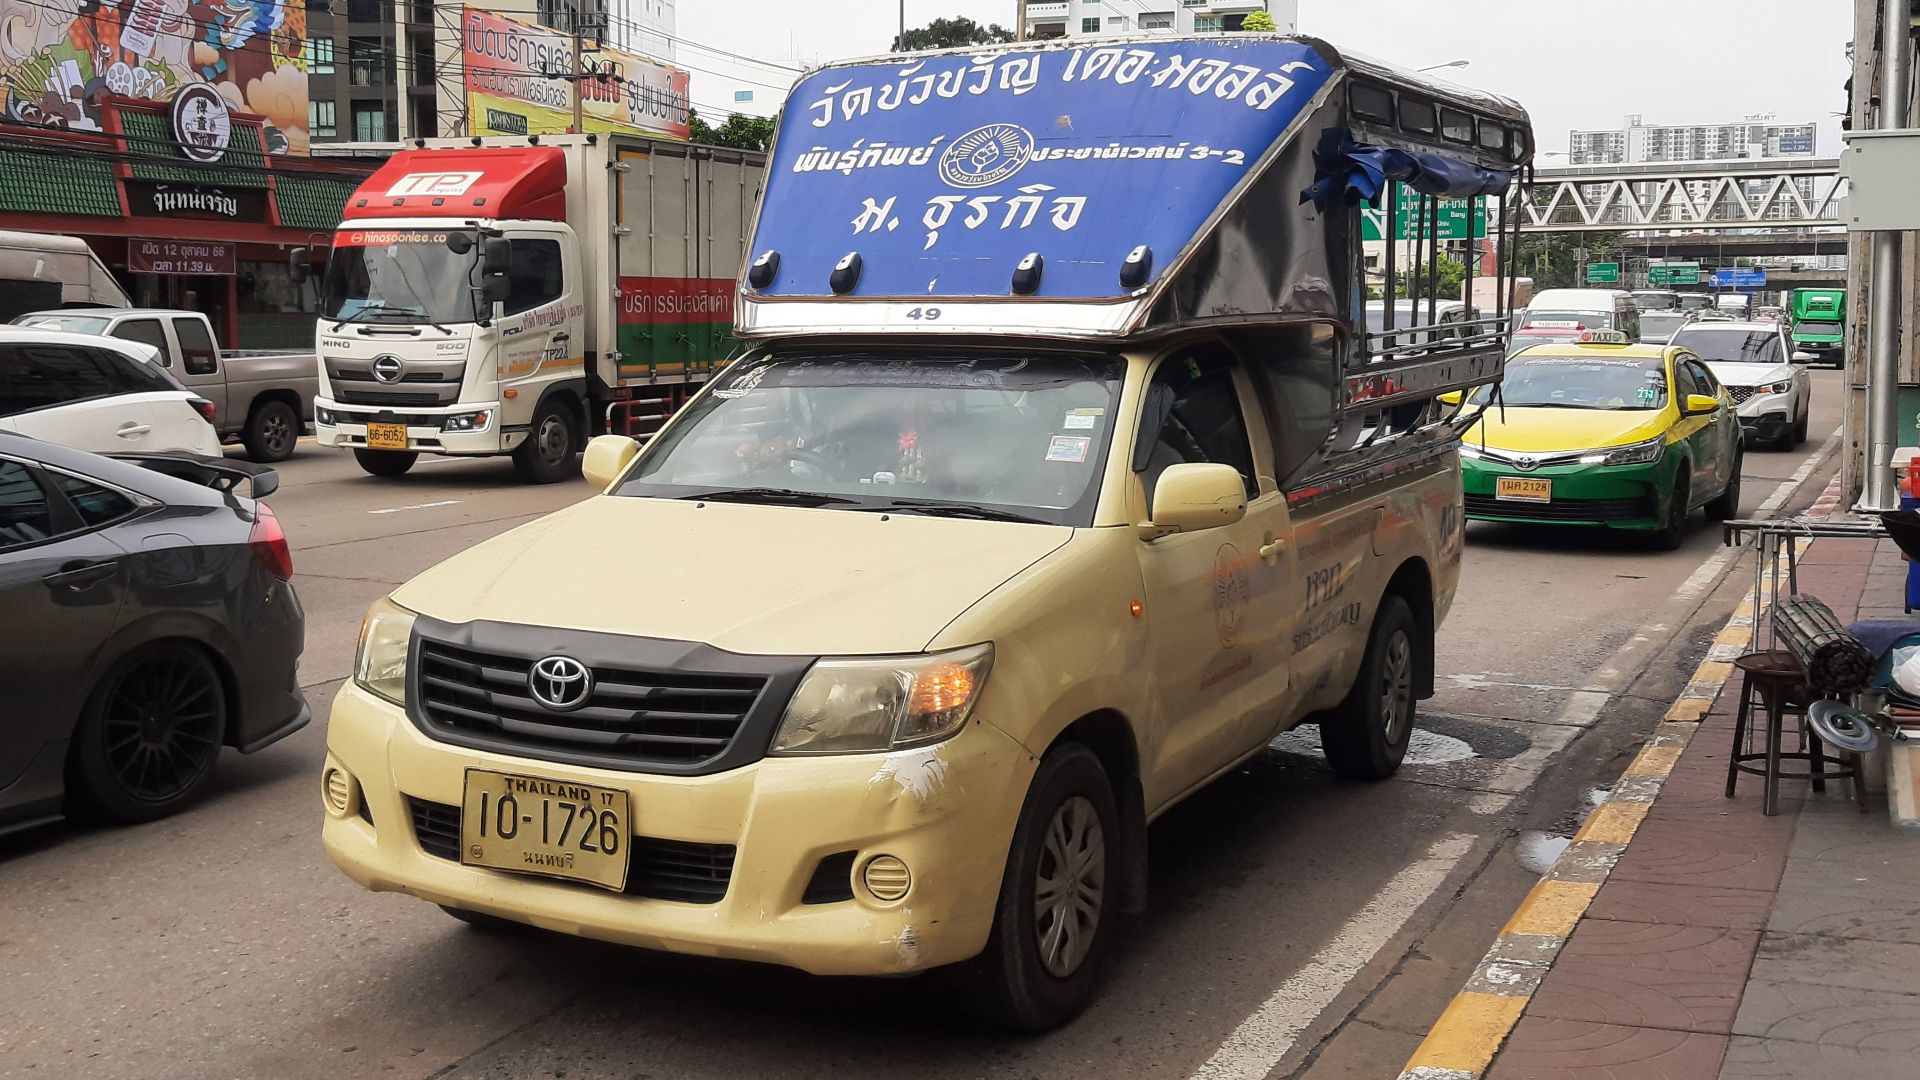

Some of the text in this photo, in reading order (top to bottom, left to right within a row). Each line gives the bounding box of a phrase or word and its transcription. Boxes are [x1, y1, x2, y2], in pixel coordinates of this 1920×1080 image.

[809, 46, 1316, 130] วัดบัวขวัญ เดอะมอลล์
[792, 134, 946, 176] พันธุ์ทิพย์
[1030, 142, 1190, 161] ประชานิเวศน์
[1189, 144, 1245, 166] 3-2
[406, 173, 470, 193] TP
[152, 183, 238, 217] จันทน์เจริญ
[851, 184, 1089, 251] ม. ธุรกิจ
[142, 242, 225, 260] เปิด 12 ตุลาคม 66
[153, 261, 173, 272] เวลา
[176, 261, 204, 273] 11.39
[905, 307, 943, 322] 49
[322, 339, 351, 349] HINO
[435, 342, 466, 350] 500
[1591, 332, 1613, 342] TAXI
[369, 429, 405, 442] 66-6052
[1523, 481, 1548, 492] 2128
[504, 776, 614, 806] THAILAND 17
[479, 791, 620, 856] 10-1726
[523, 850, 575, 873] นนทบุรี
